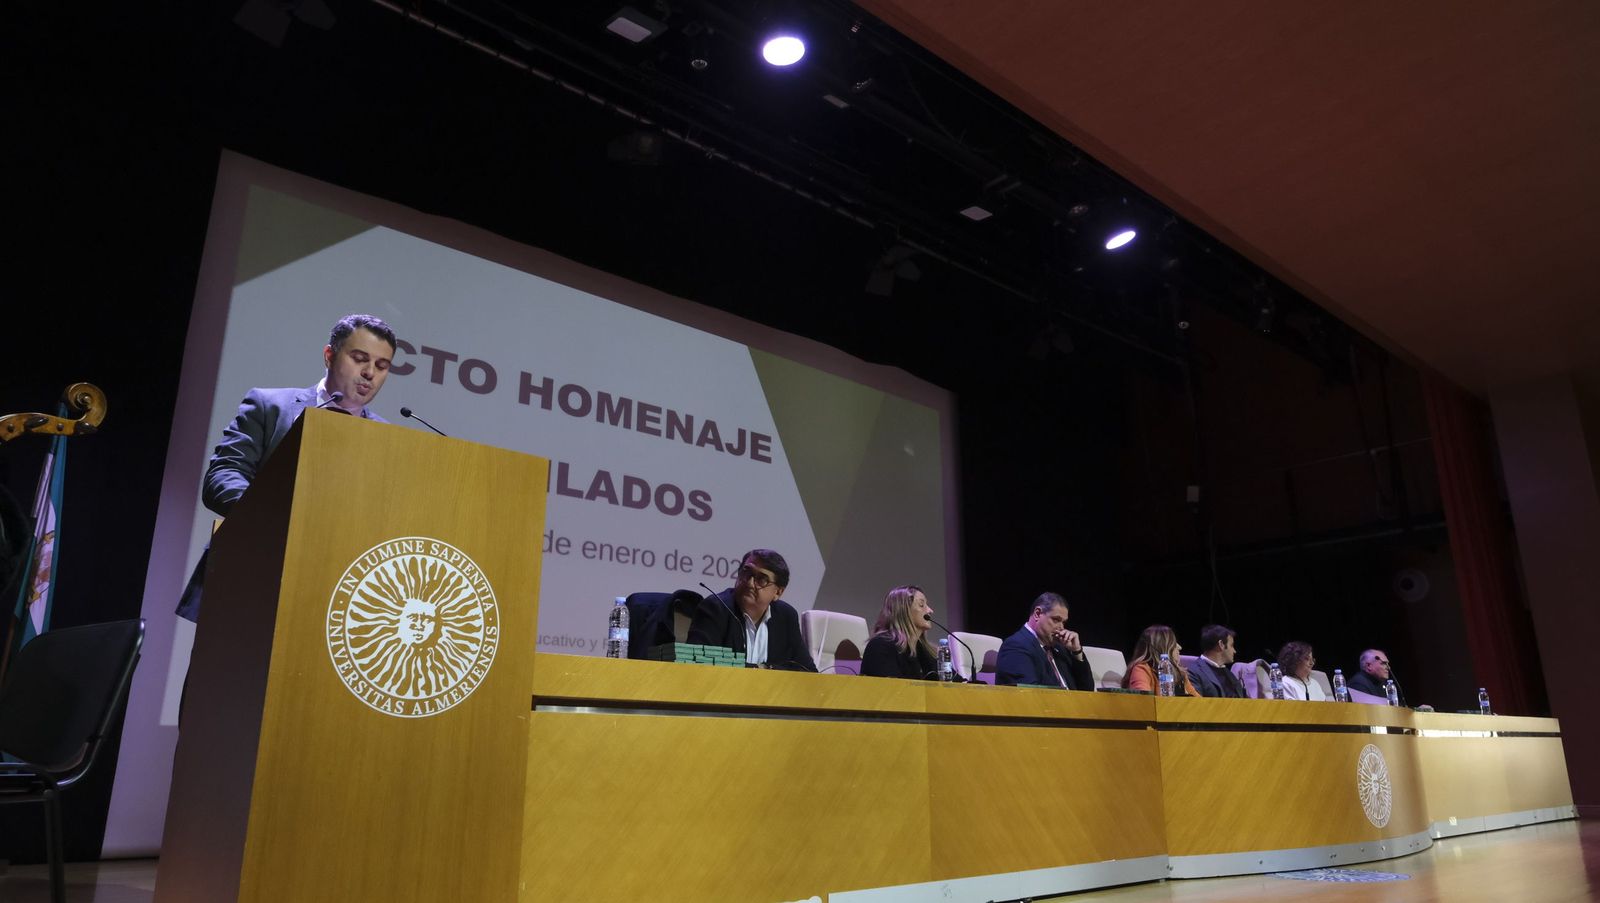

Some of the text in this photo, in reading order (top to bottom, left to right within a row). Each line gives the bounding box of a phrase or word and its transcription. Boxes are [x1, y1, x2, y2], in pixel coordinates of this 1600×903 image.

[388, 338, 773, 464] CTO HOMENAJE
[546, 459, 713, 522] LADOS
[339, 540, 495, 612] IN LUMINE SAPIENTIA
[541, 529, 742, 580] de enero de 202
[329, 609, 497, 715] UNIVERSITAS ALMERIENSIS
